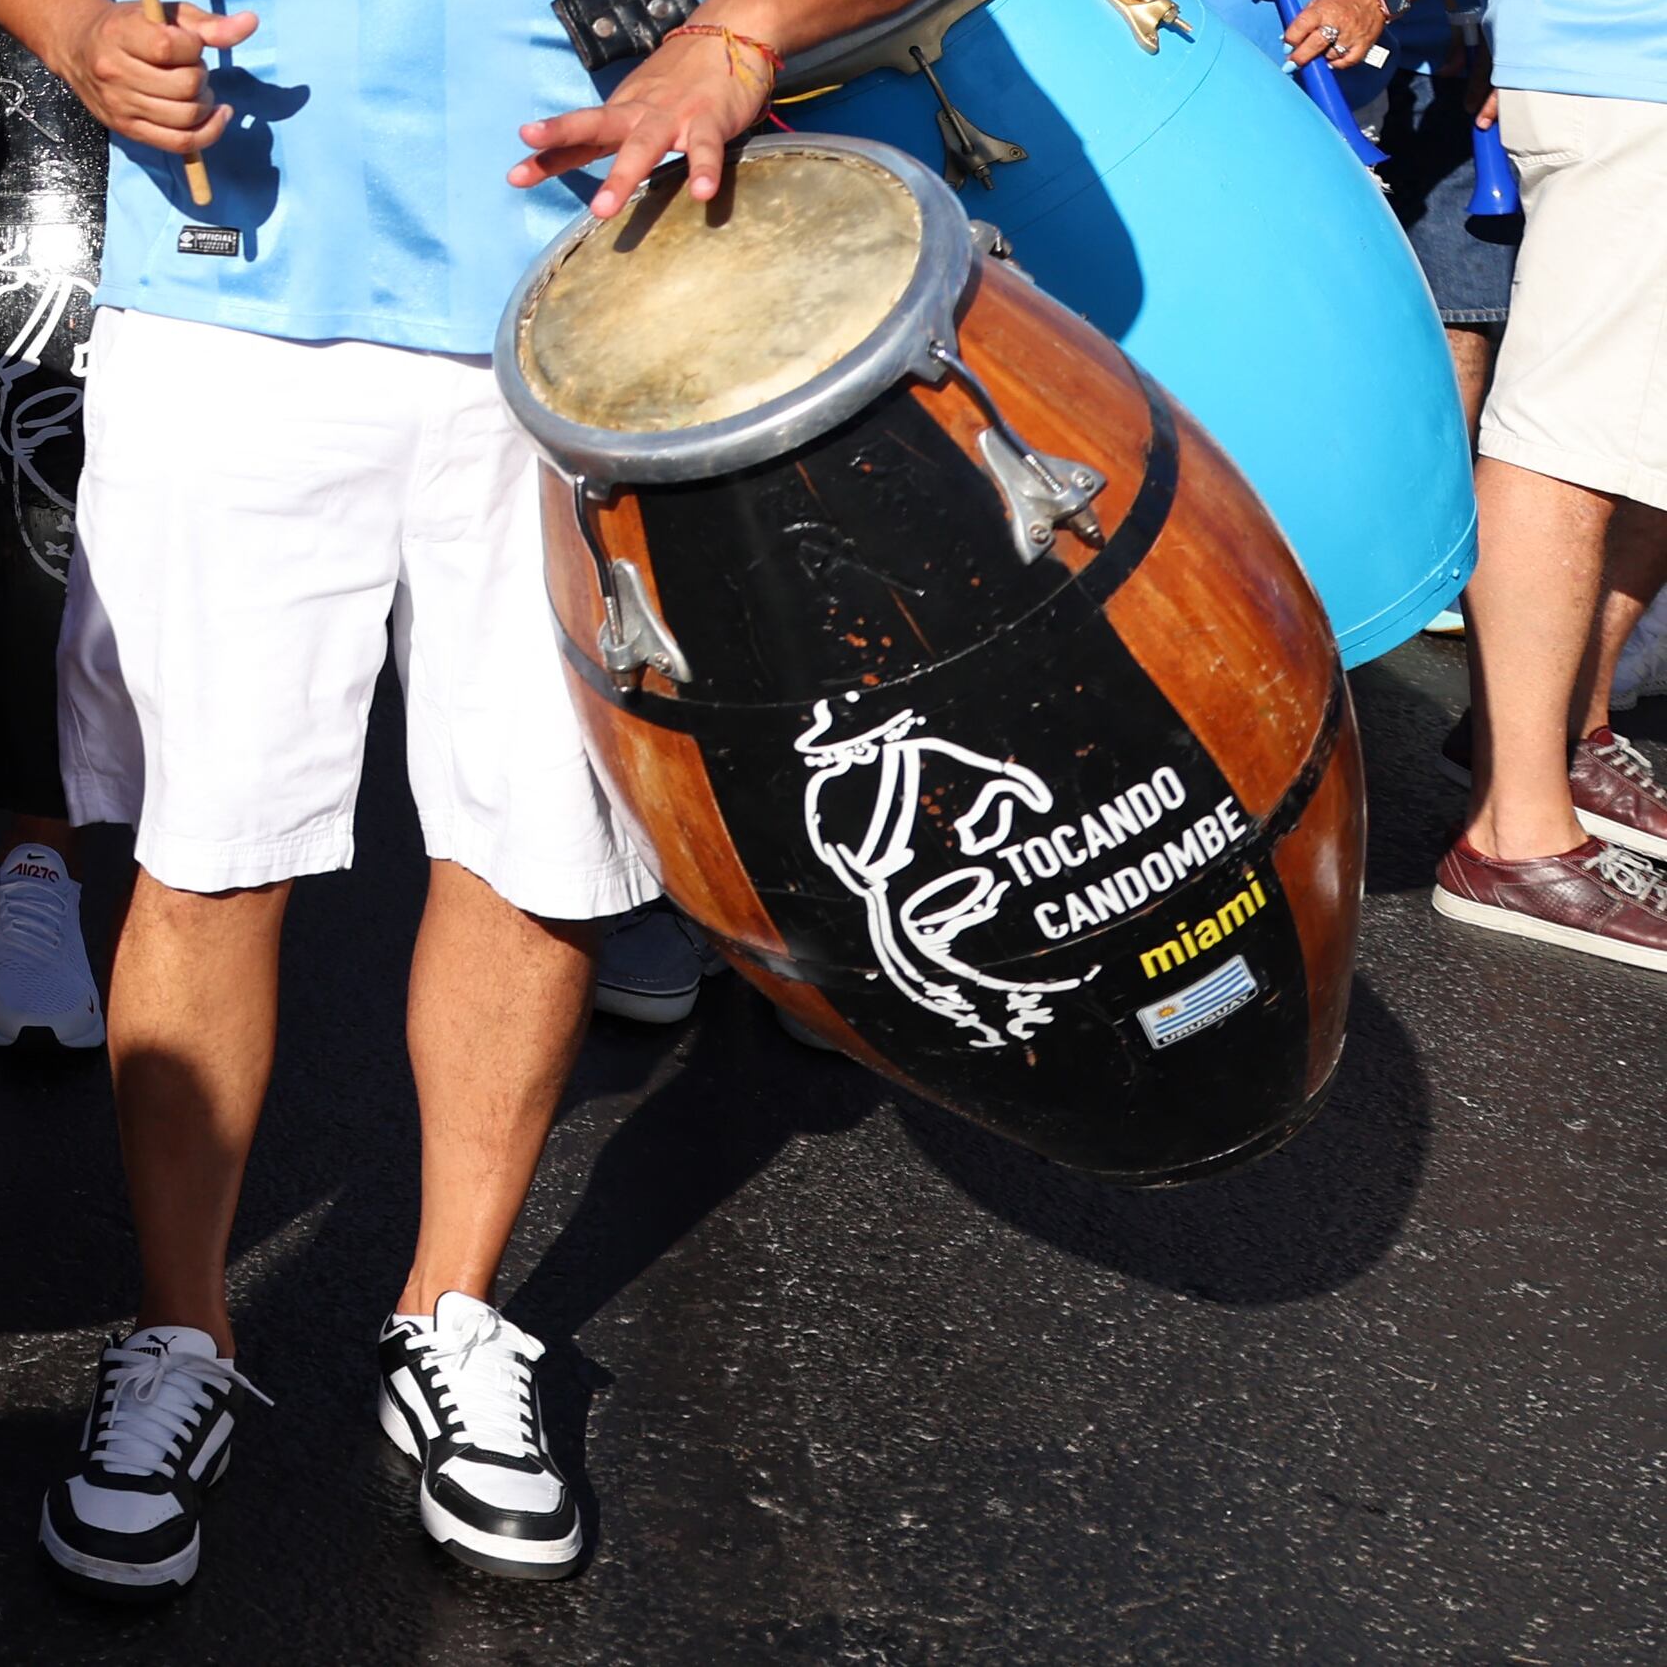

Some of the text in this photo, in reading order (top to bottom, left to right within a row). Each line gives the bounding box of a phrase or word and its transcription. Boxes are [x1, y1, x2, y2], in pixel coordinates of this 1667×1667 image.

[196, 233, 233, 242] OFFICIAL
[997, 765, 1186, 887] TOCANDO
[1033, 796, 1249, 940] CANDOMBE
[1138, 871, 1267, 980] miami
[1162, 993, 1249, 1043] URUGUAY
